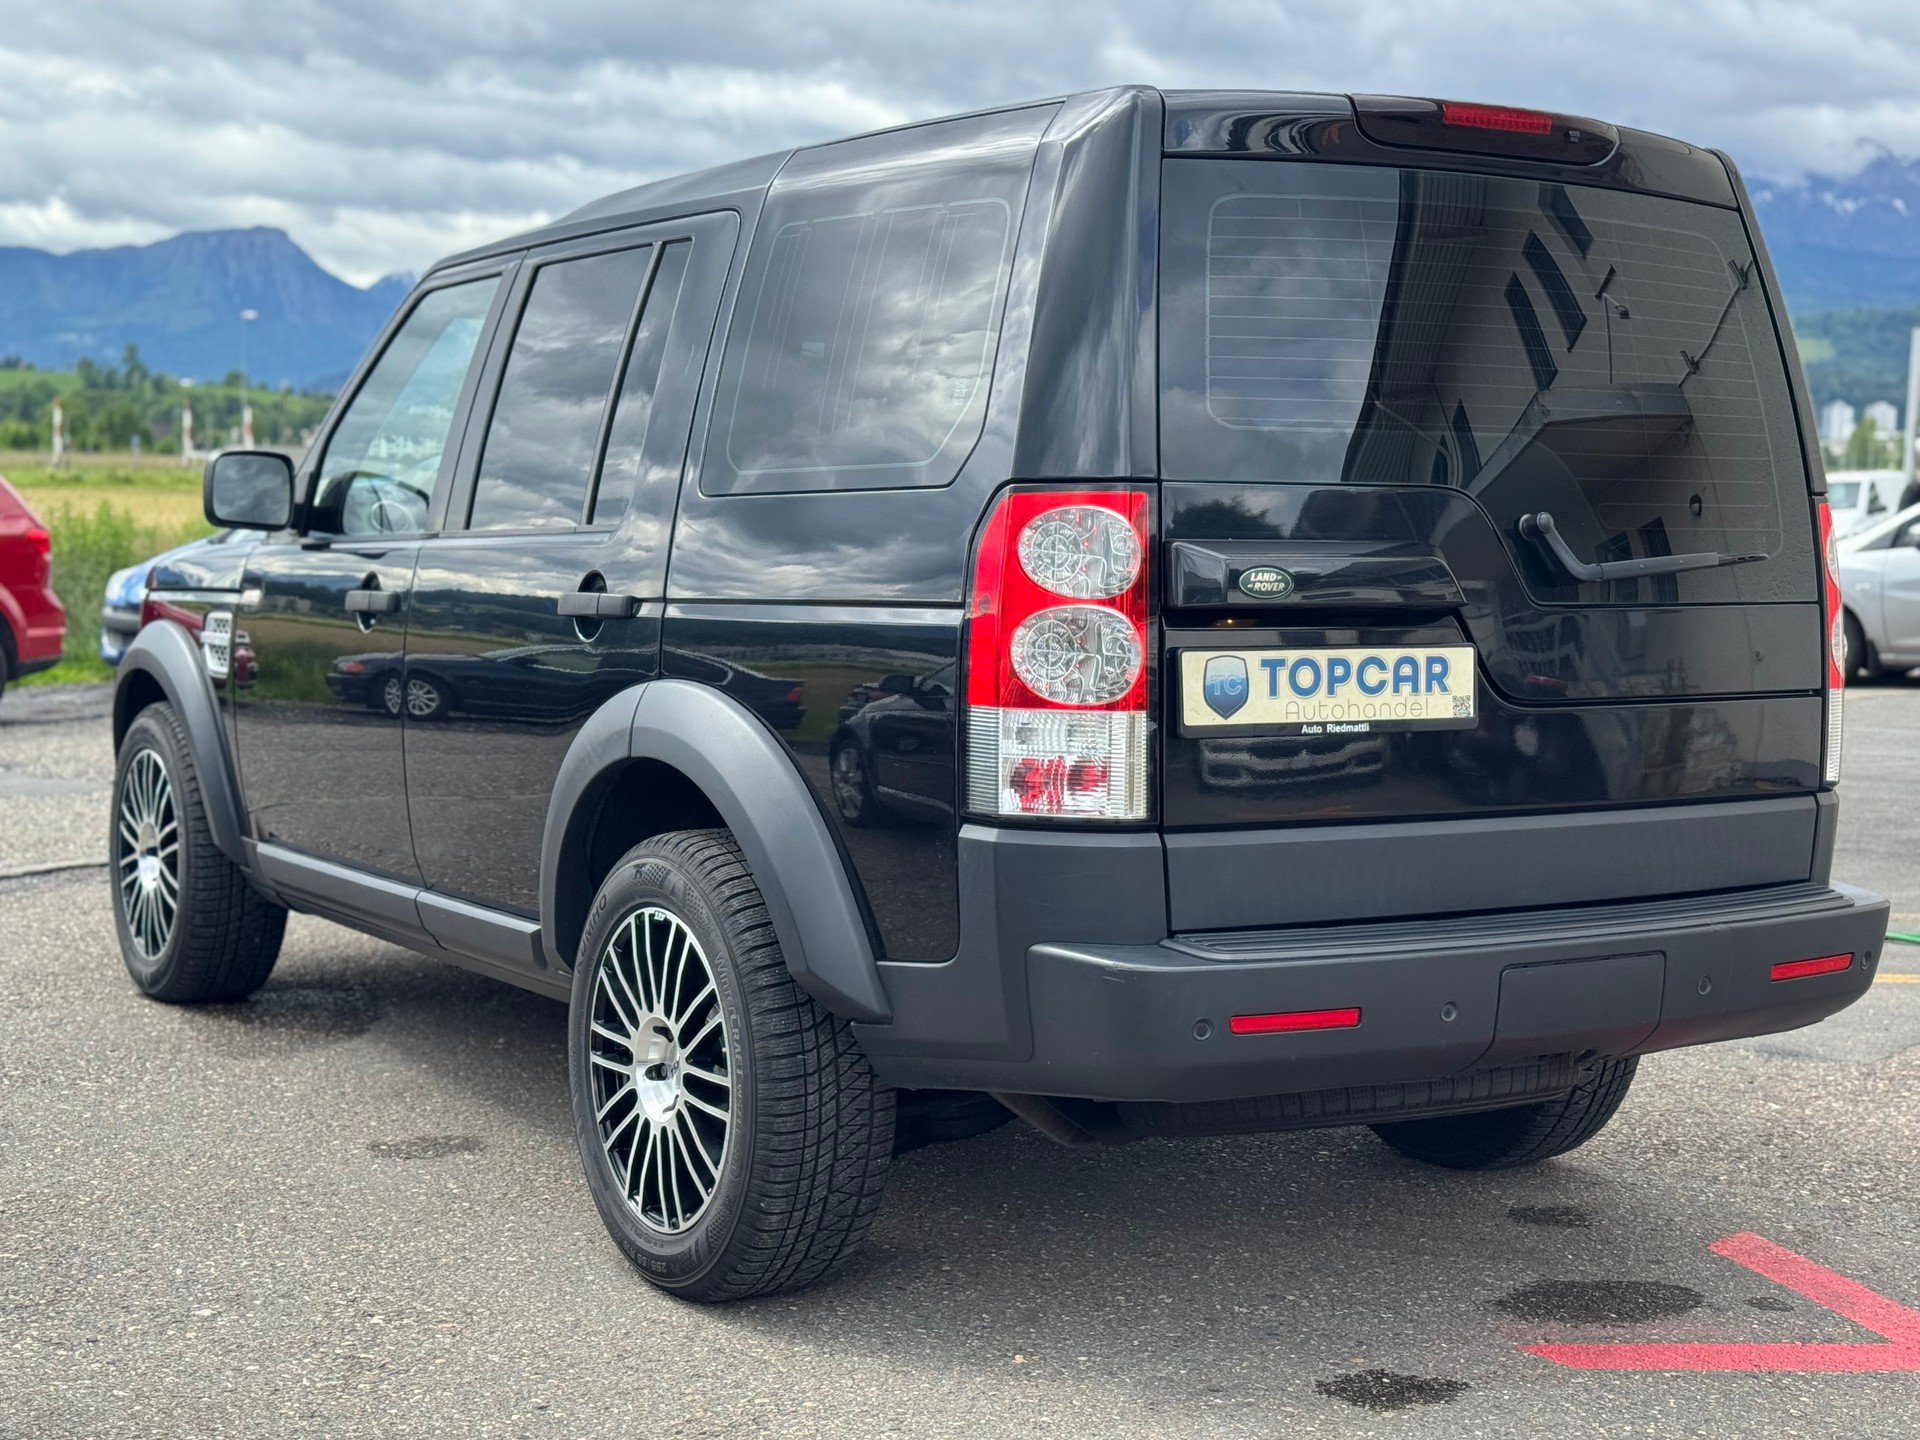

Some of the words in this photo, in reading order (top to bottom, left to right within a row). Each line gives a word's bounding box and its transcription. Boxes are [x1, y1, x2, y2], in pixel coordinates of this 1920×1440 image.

[1250, 572, 1277, 581] LAND
[1253, 582, 1285, 591] ROVER
[1211, 674, 1242, 695] TC
[1260, 655, 1451, 698] TOPCAR
[1285, 697, 1428, 720] Autohandel
[1301, 724, 1323, 733] Auto
[1326, 722, 1370, 733] Riedmattli
